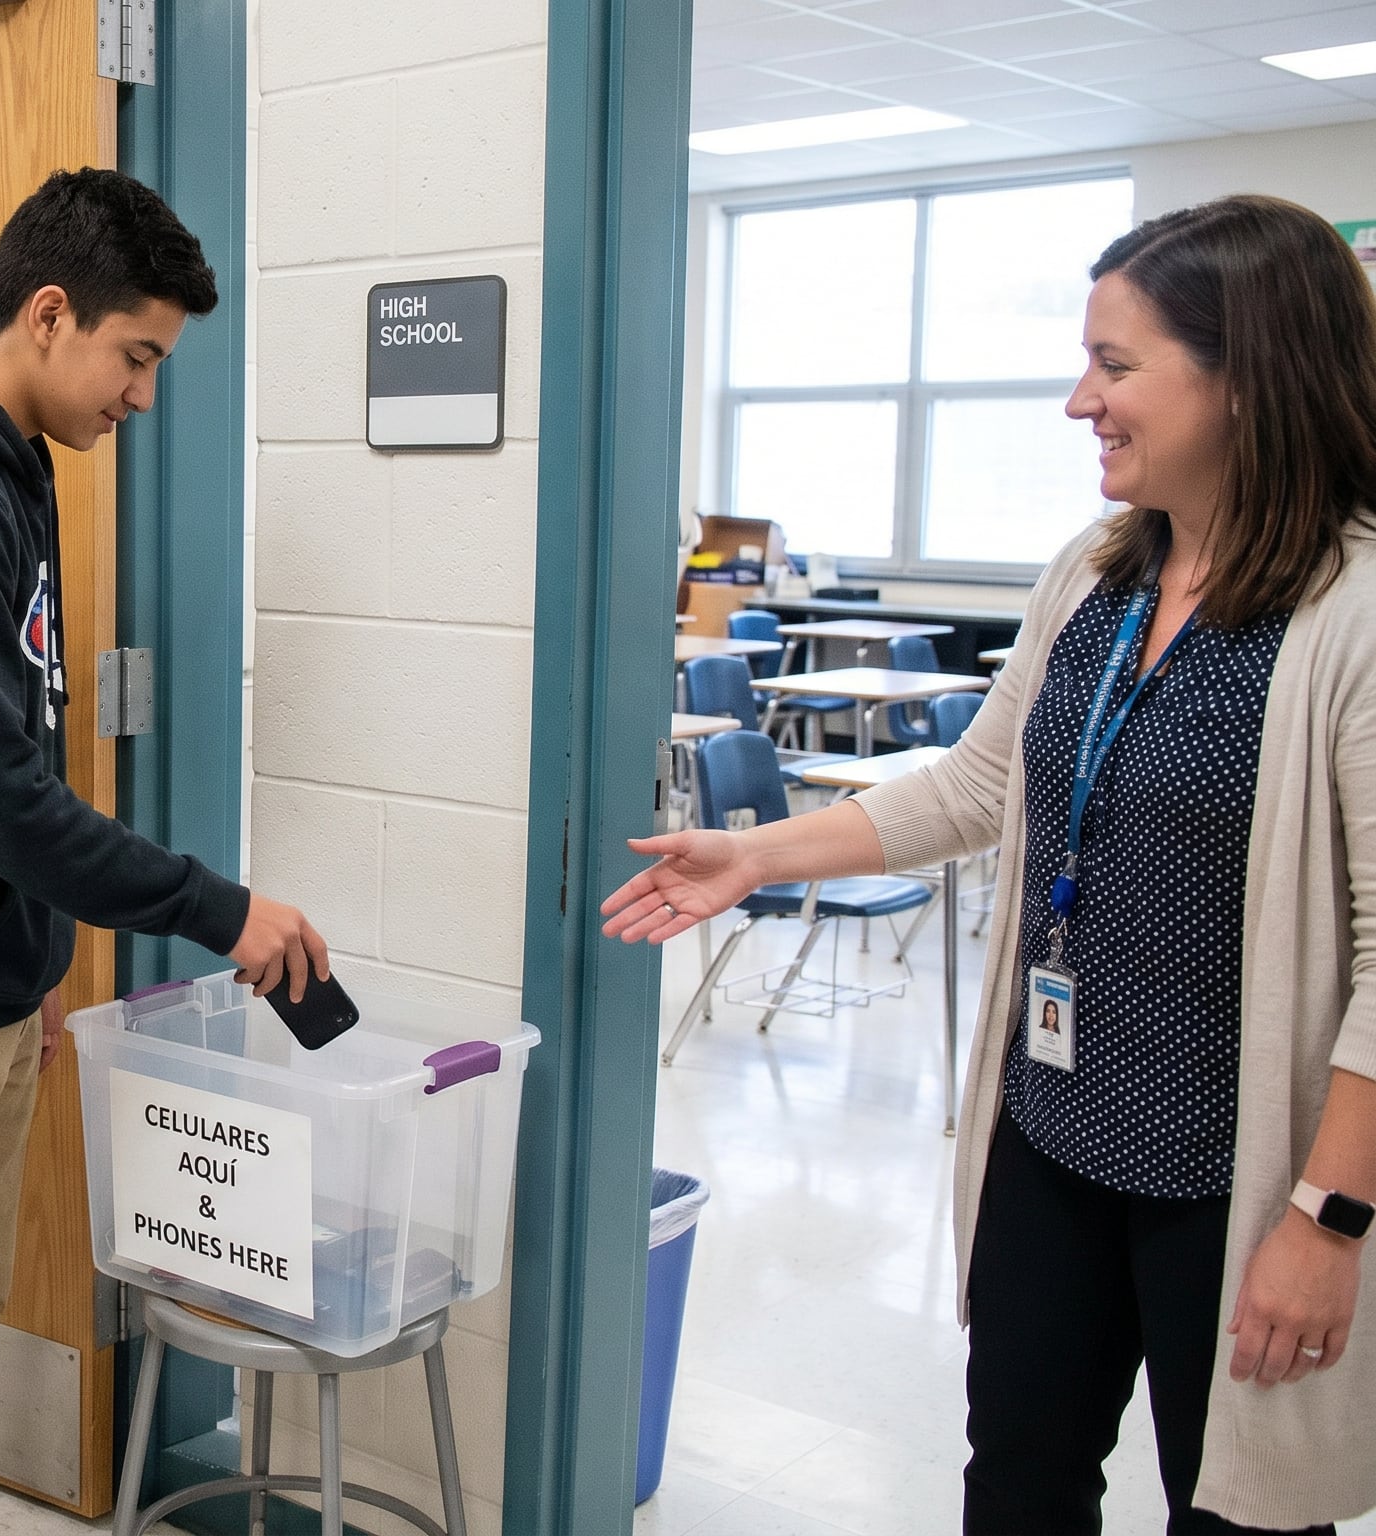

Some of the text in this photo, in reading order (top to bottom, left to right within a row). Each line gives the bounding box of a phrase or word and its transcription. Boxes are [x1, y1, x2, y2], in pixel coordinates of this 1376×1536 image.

[380, 296, 427, 319] HIGH
[379, 321, 463, 347] SCHOOL
[144, 1103, 271, 1157] CELULARES
[178, 1151, 238, 1187] AQUÍ
[198, 1194, 217, 1221] &
[134, 1212, 289, 1281] PHONES HERE
